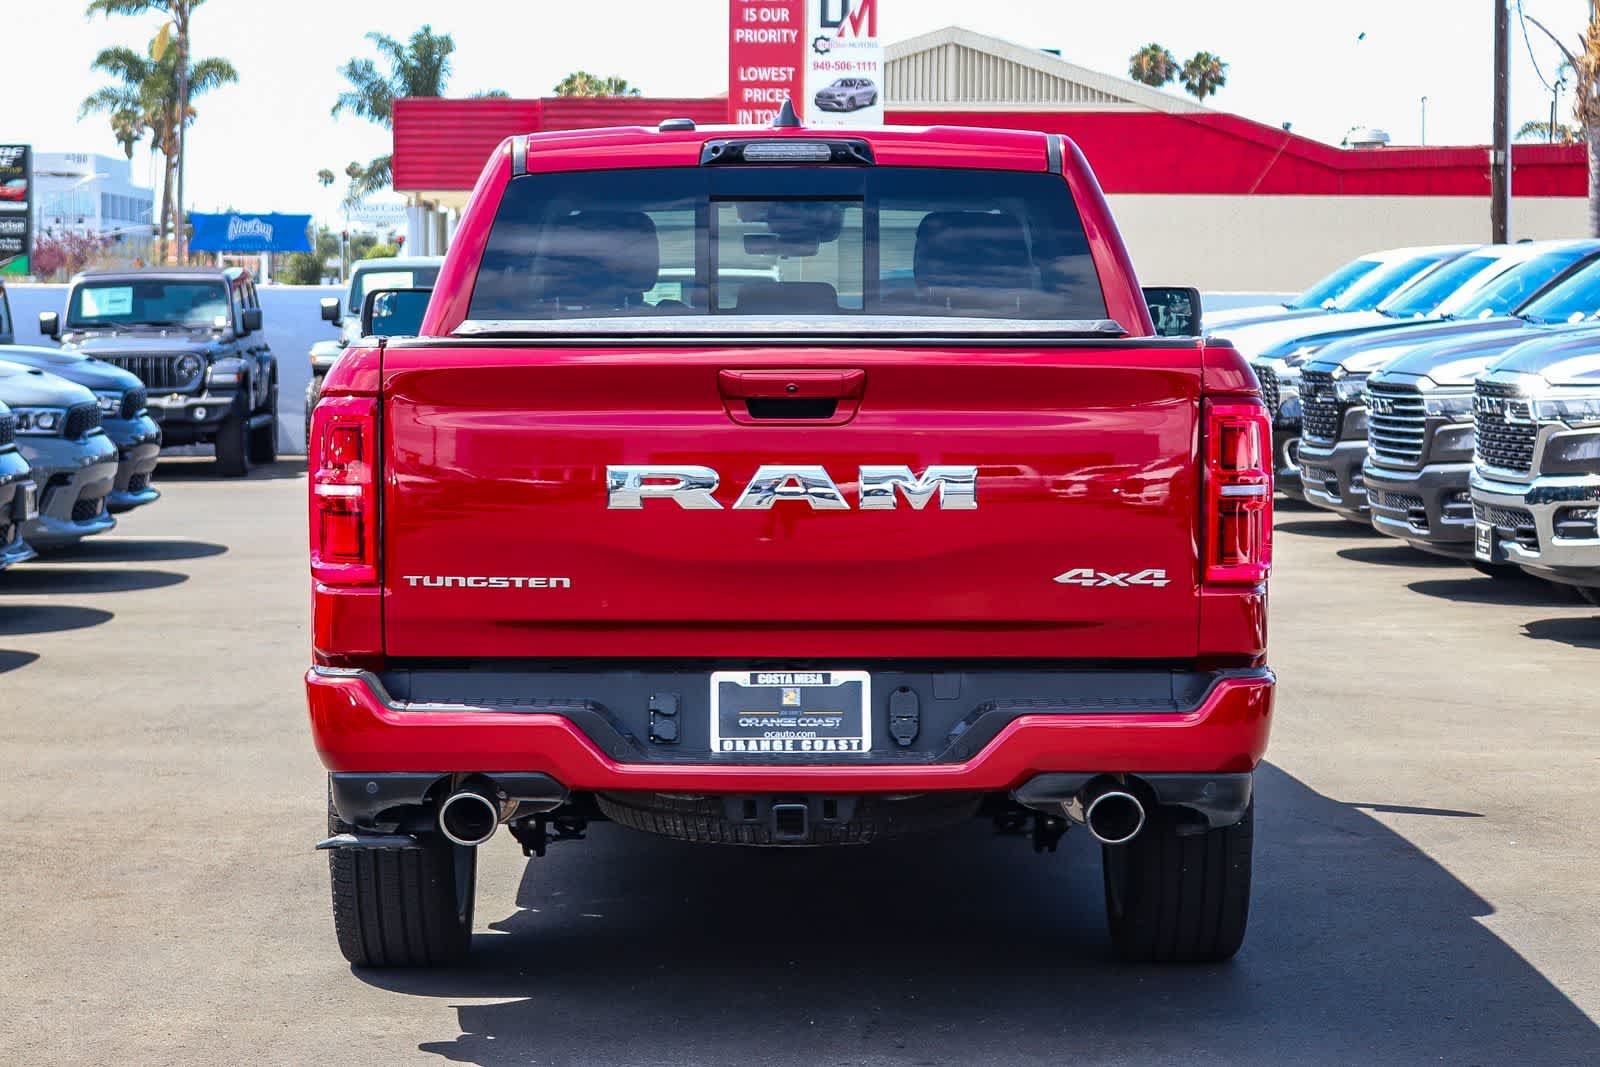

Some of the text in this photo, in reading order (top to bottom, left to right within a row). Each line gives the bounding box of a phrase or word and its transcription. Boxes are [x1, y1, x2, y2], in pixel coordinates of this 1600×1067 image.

[745, 7, 790, 22] IS OUR
[735, 28, 799, 43] PRIORITY
[739, 66, 796, 82] LOWEST
[813, 61, 877, 72] 949-506-1111
[744, 88, 791, 103] PRICES
[737, 109, 780, 125] IN TO
[606, 465, 979, 511] RAM
[403, 574, 572, 590] TUNGSTEN
[1053, 568, 1170, 588] 4x4
[757, 673, 824, 685] COSTA MESA
[738, 717, 842, 727] ORANGE COAST
[763, 730, 816, 739] ocauto.com
[722, 740, 860, 751] ORANGE COAST
